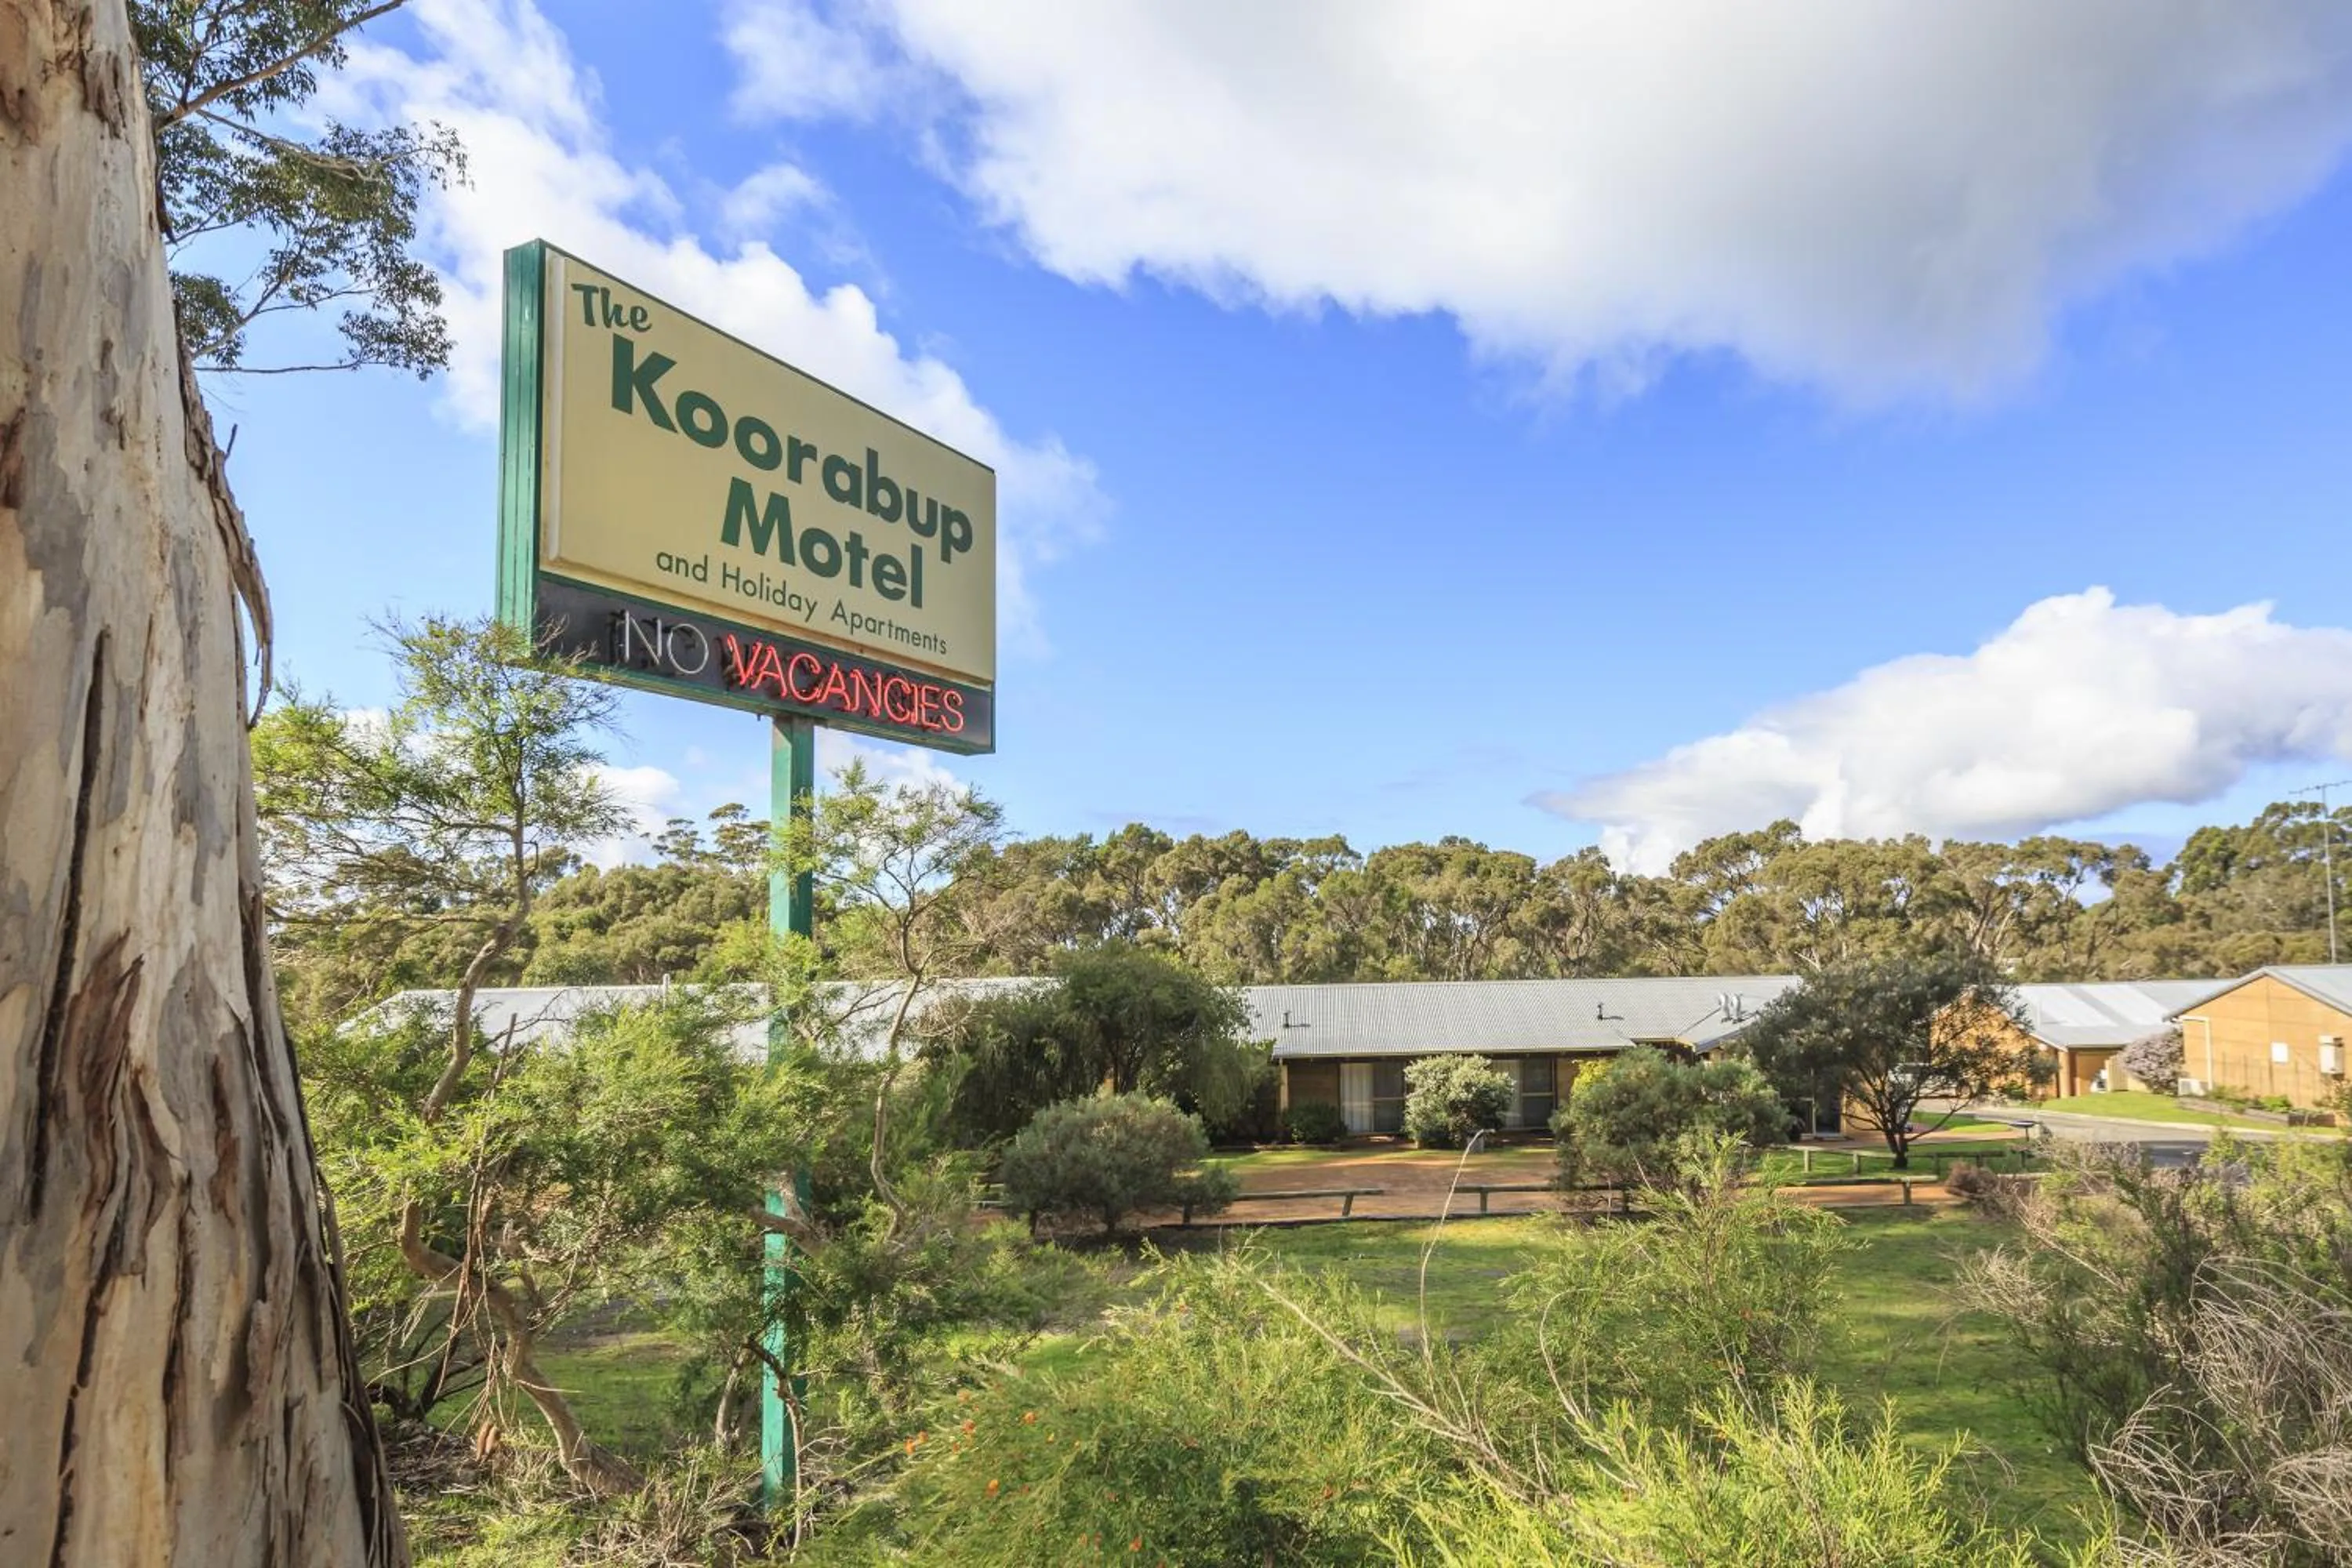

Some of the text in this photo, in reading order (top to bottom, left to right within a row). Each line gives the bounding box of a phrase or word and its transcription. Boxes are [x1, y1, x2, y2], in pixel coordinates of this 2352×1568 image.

[571, 283, 652, 332] The
[612, 333, 973, 564] Koorabup
[655, 553, 947, 655] and Holiday Apartments
[720, 477, 923, 609] Motel
[622, 610, 964, 733] NO VACANCIES
